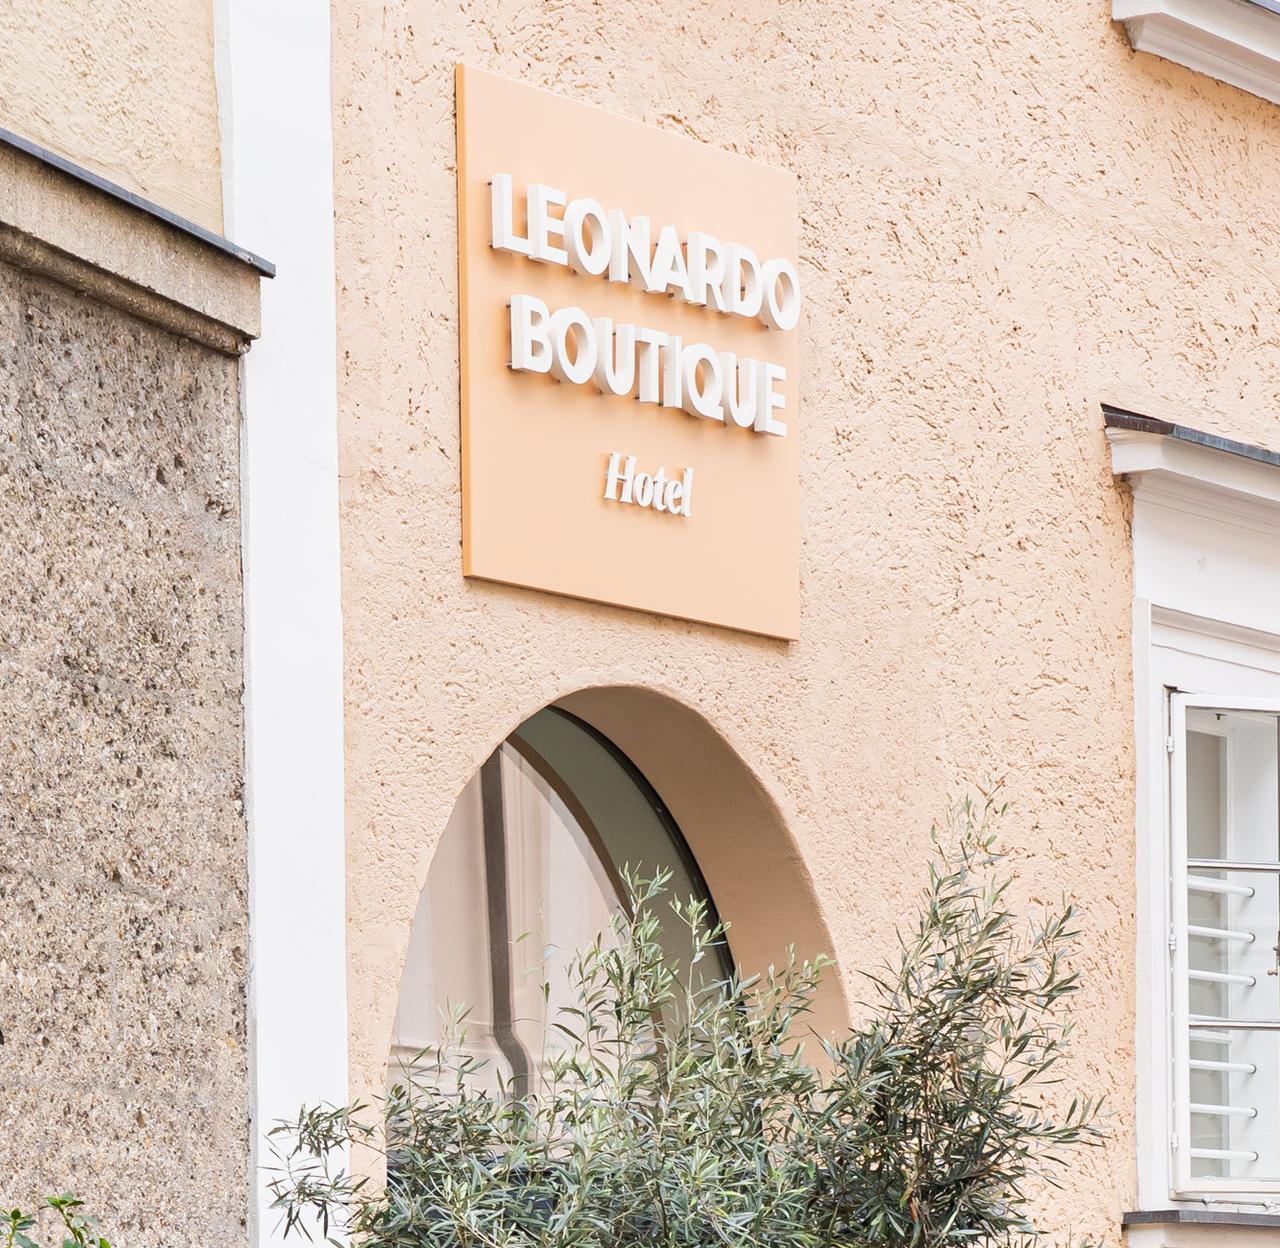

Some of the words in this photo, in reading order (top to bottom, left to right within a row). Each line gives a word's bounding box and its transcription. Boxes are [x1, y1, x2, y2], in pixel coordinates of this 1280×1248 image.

[491, 174, 801, 331] LEONARDO
[510, 295, 787, 437] BOUTIQUE
[603, 452, 694, 518] Hotel
